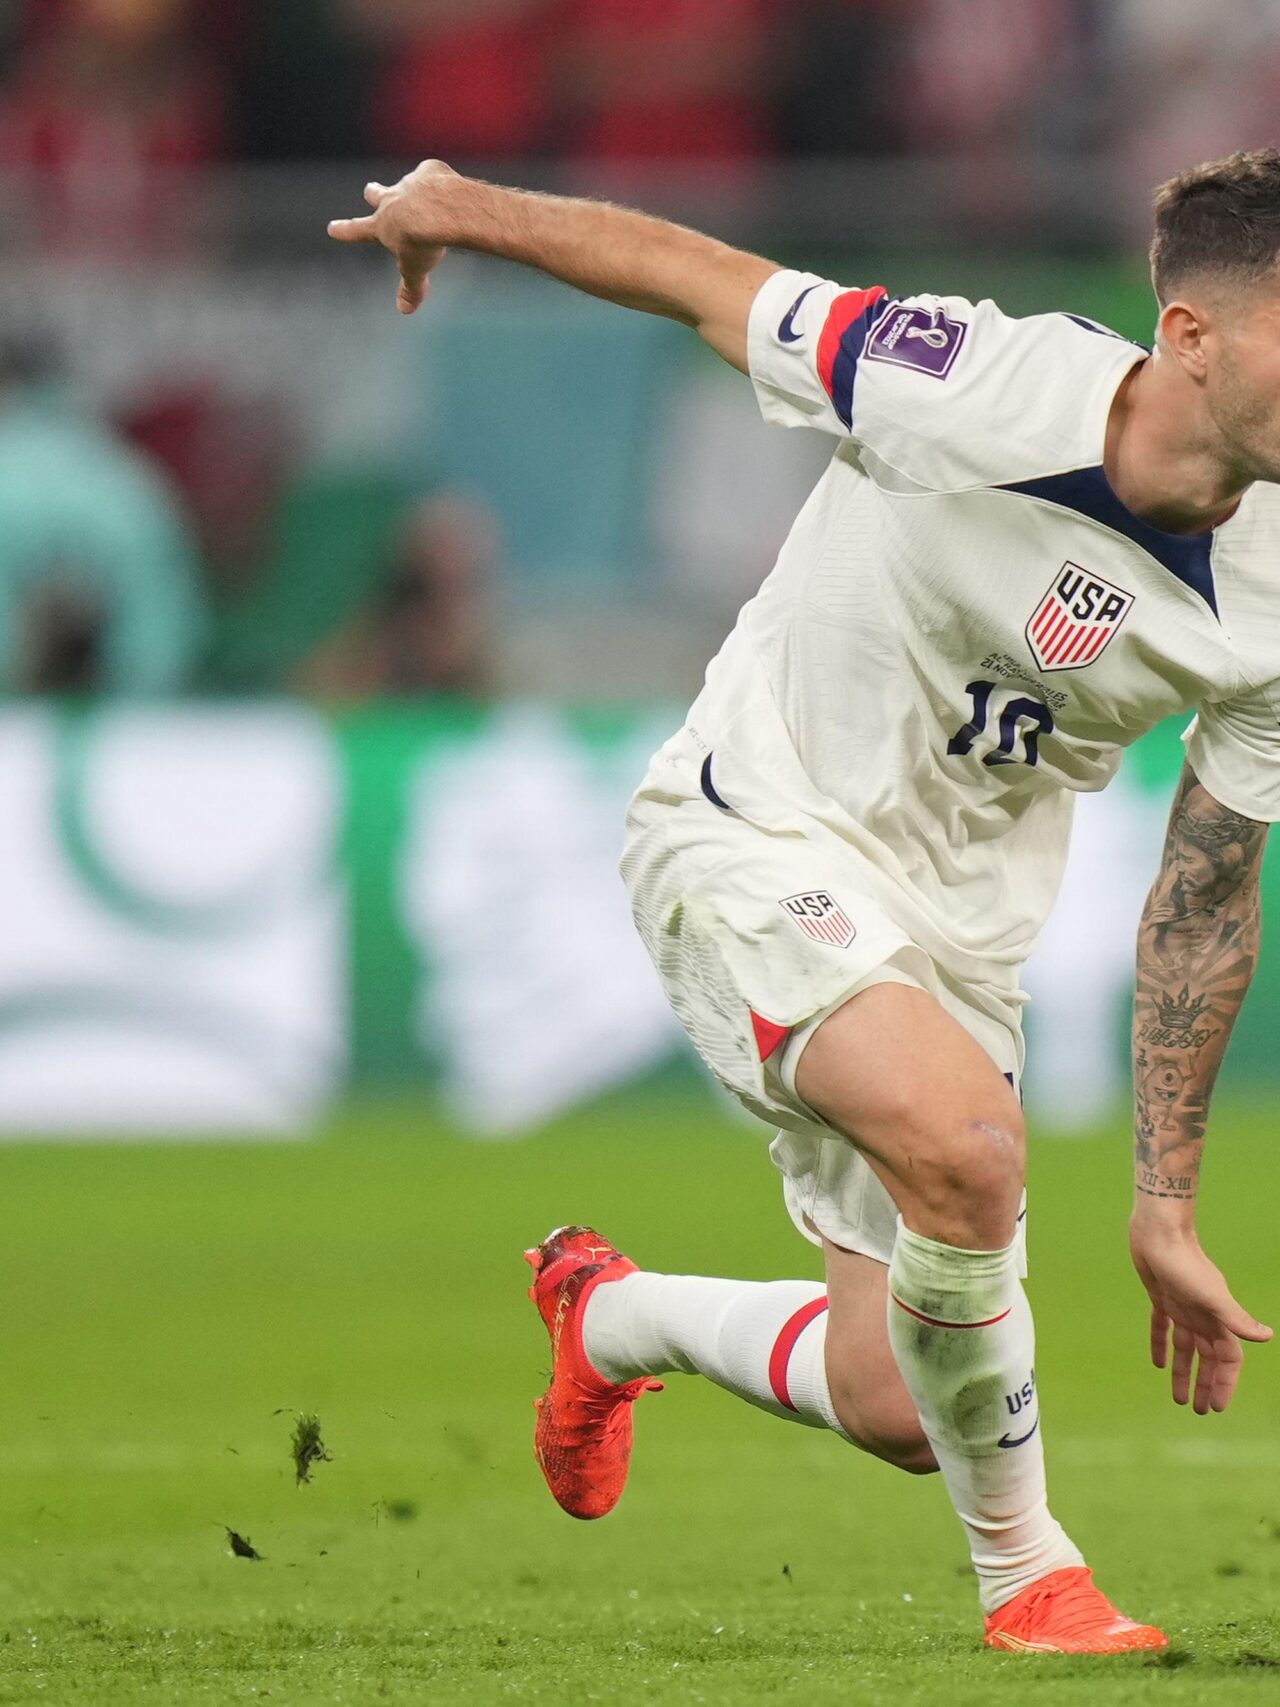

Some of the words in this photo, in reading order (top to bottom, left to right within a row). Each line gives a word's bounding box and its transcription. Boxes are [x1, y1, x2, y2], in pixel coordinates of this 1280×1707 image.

[1057, 569, 1126, 622] USA
[980, 657, 994, 669] 21
[947, 680, 1054, 767] 10
[786, 894, 834, 918] USA
